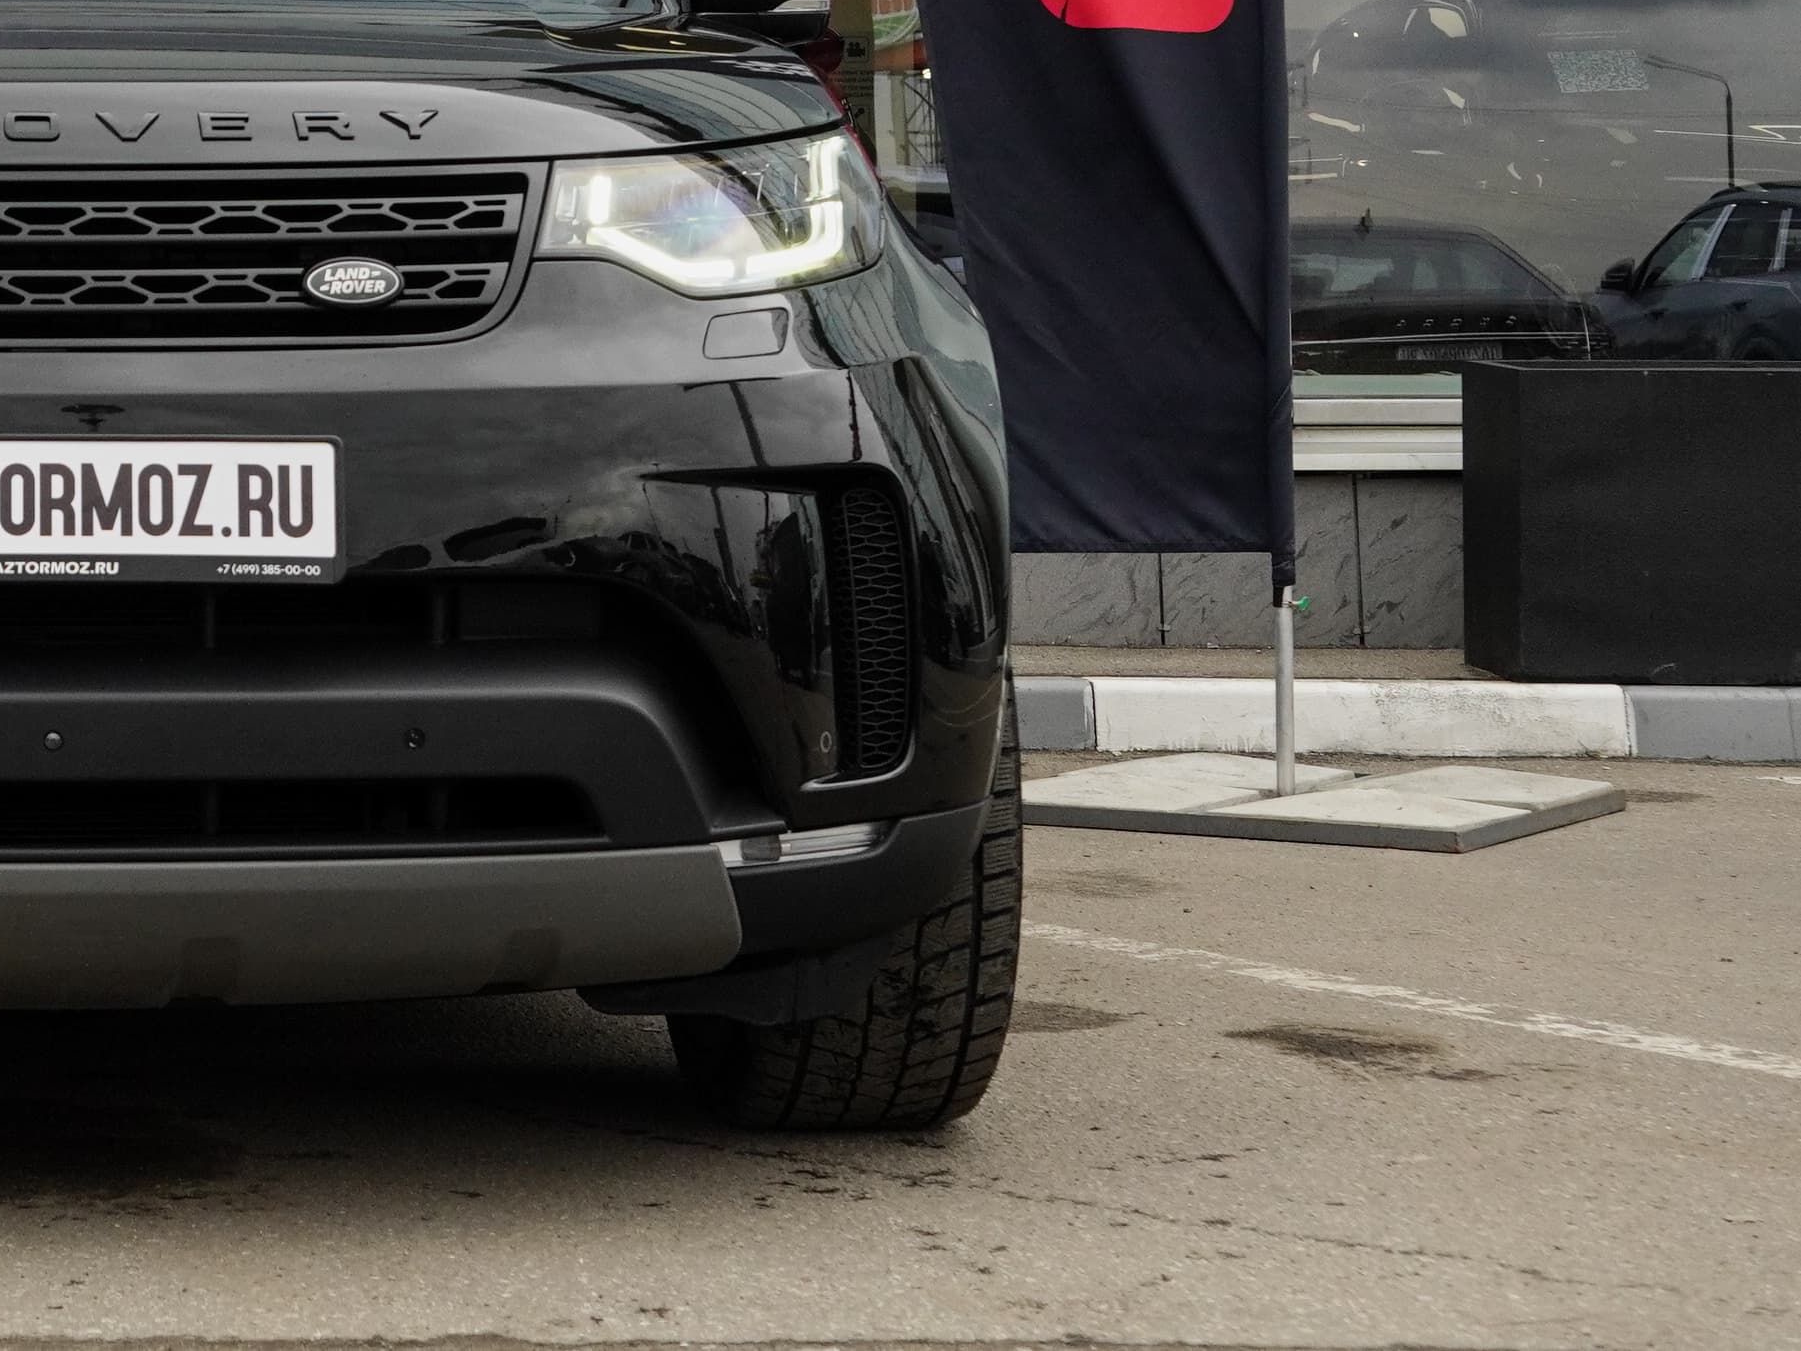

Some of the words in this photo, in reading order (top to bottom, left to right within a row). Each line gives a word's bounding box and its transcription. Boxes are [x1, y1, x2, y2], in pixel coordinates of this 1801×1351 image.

[324, 267, 370, 282] LAND
[329, 279, 387, 295] ROVER
[216, 564, 229, 575] +7
[231, 563, 260, 577] (499)
[261, 563, 322, 577] 385-00-00
